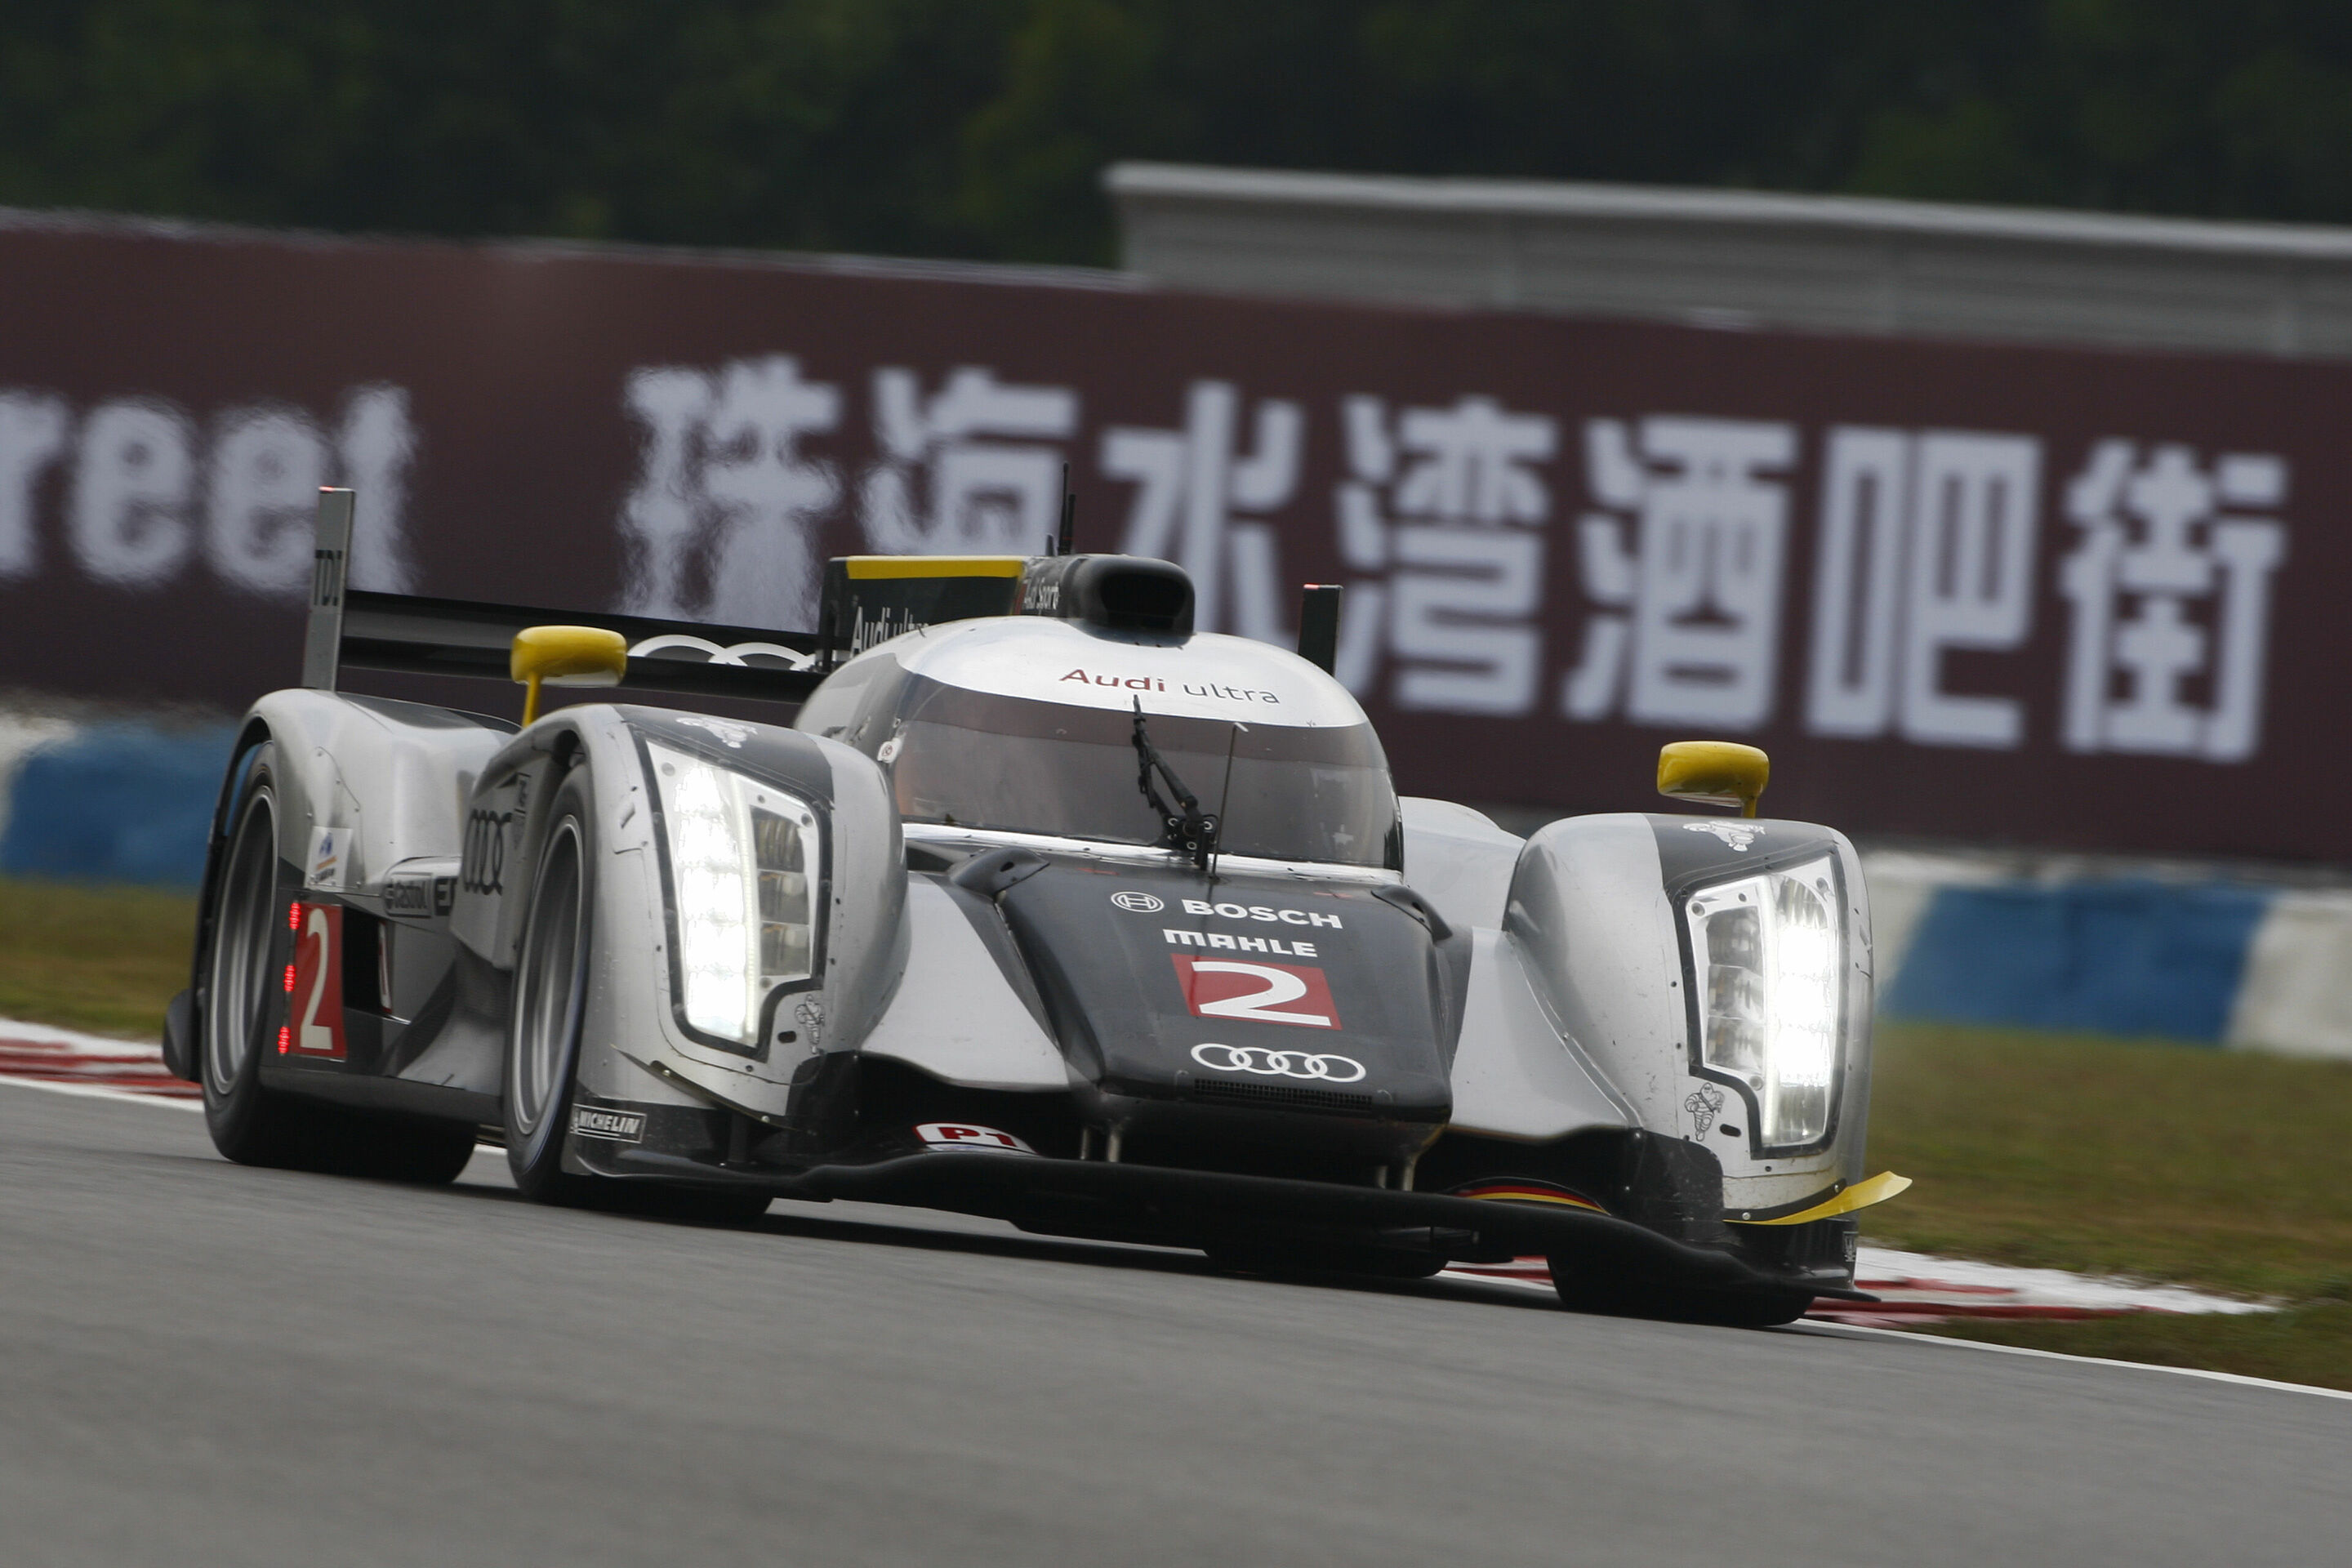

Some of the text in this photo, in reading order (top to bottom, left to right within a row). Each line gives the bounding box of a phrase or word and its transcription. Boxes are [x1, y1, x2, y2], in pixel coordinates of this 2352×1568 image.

[849, 606, 891, 658] Audi
[1058, 668, 1281, 705] Audi ultra
[1181, 898, 1343, 929] BOSCH
[1162, 928, 1319, 958] MAHLE
[299, 907, 333, 1050] 2
[1191, 960, 1332, 1027] 2
[579, 1110, 641, 1134] MICHELIN
[938, 1126, 1018, 1147] P1
